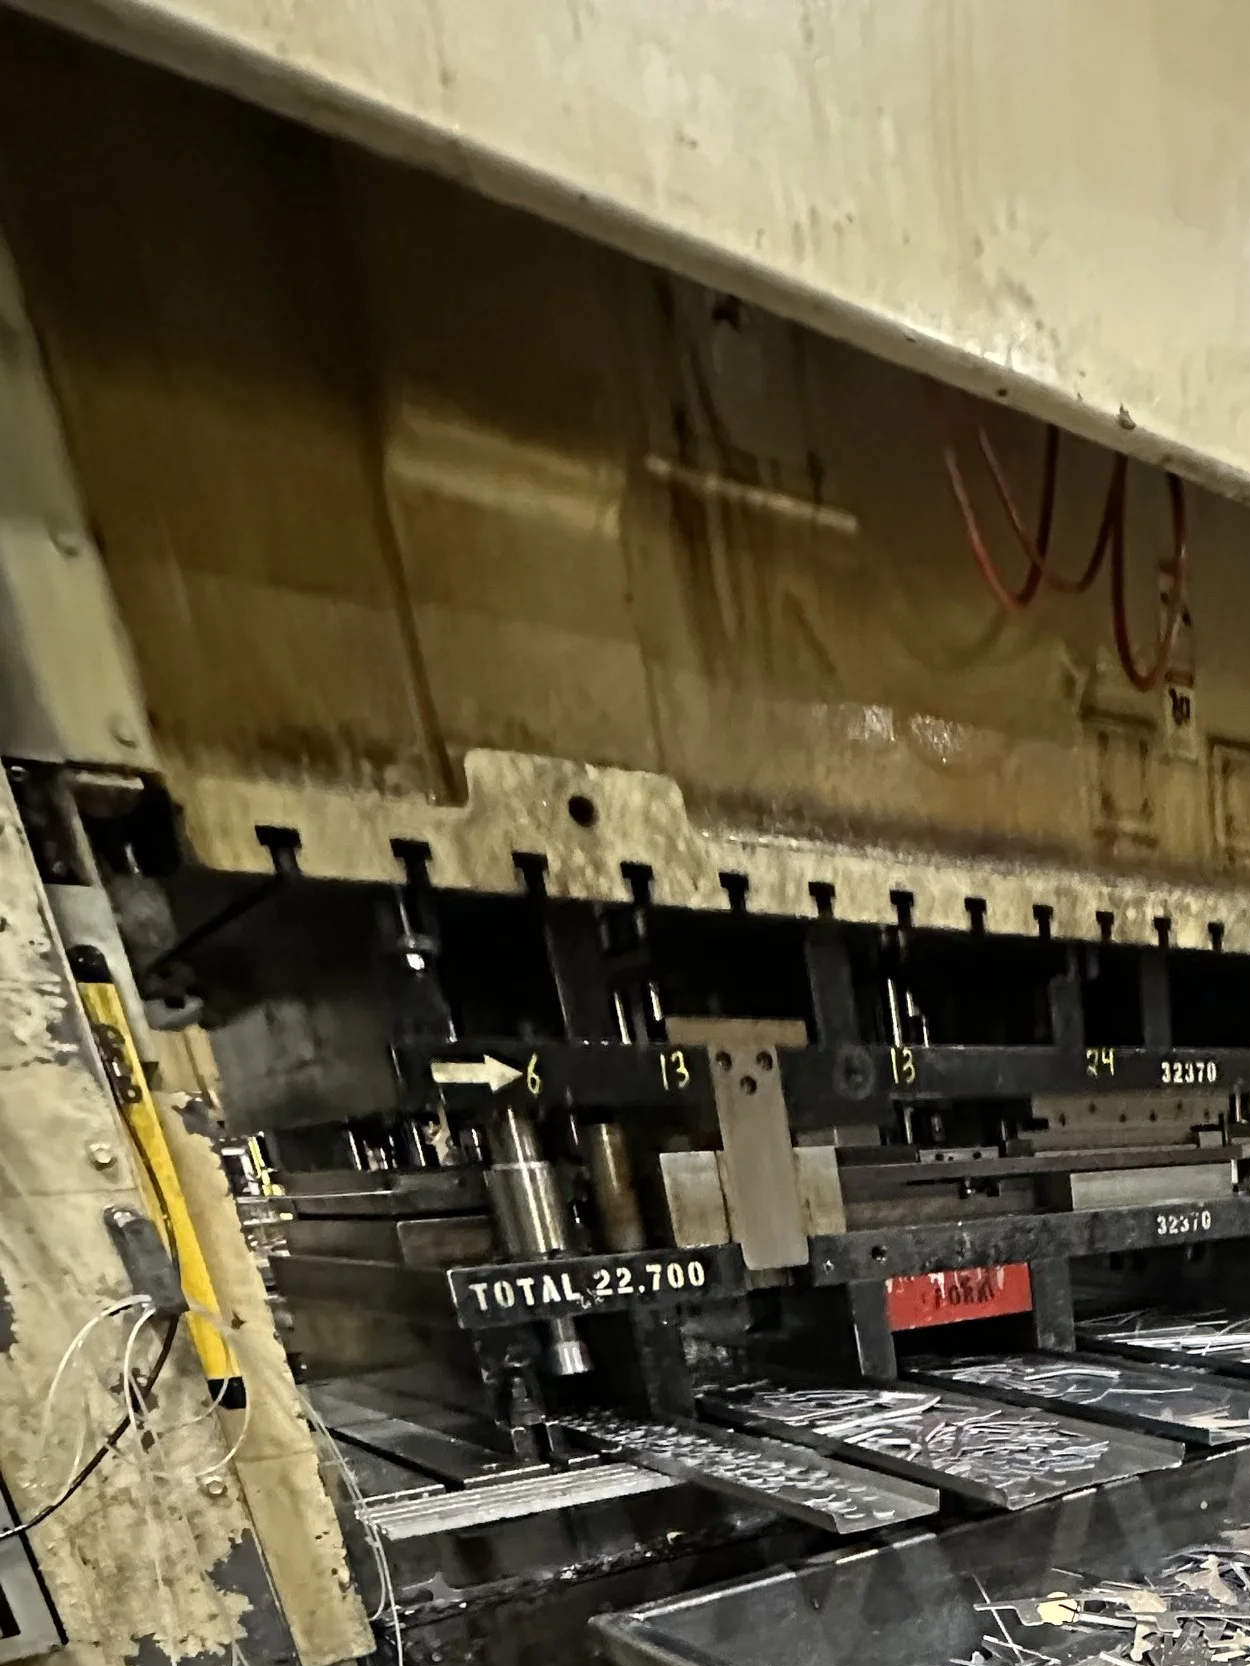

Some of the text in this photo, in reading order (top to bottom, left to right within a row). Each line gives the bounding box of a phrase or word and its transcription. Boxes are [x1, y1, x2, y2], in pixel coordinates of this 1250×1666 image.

[525, 1052, 542, 1095] 6
[659, 1050, 692, 1092] 13
[889, 1046, 916, 1084] 13
[1086, 1047, 1115, 1078] 24
[1160, 1061, 1217, 1084] 32370
[1157, 1210, 1212, 1235] 32370
[468, 1260, 706, 1312] TOTAL 22.700
